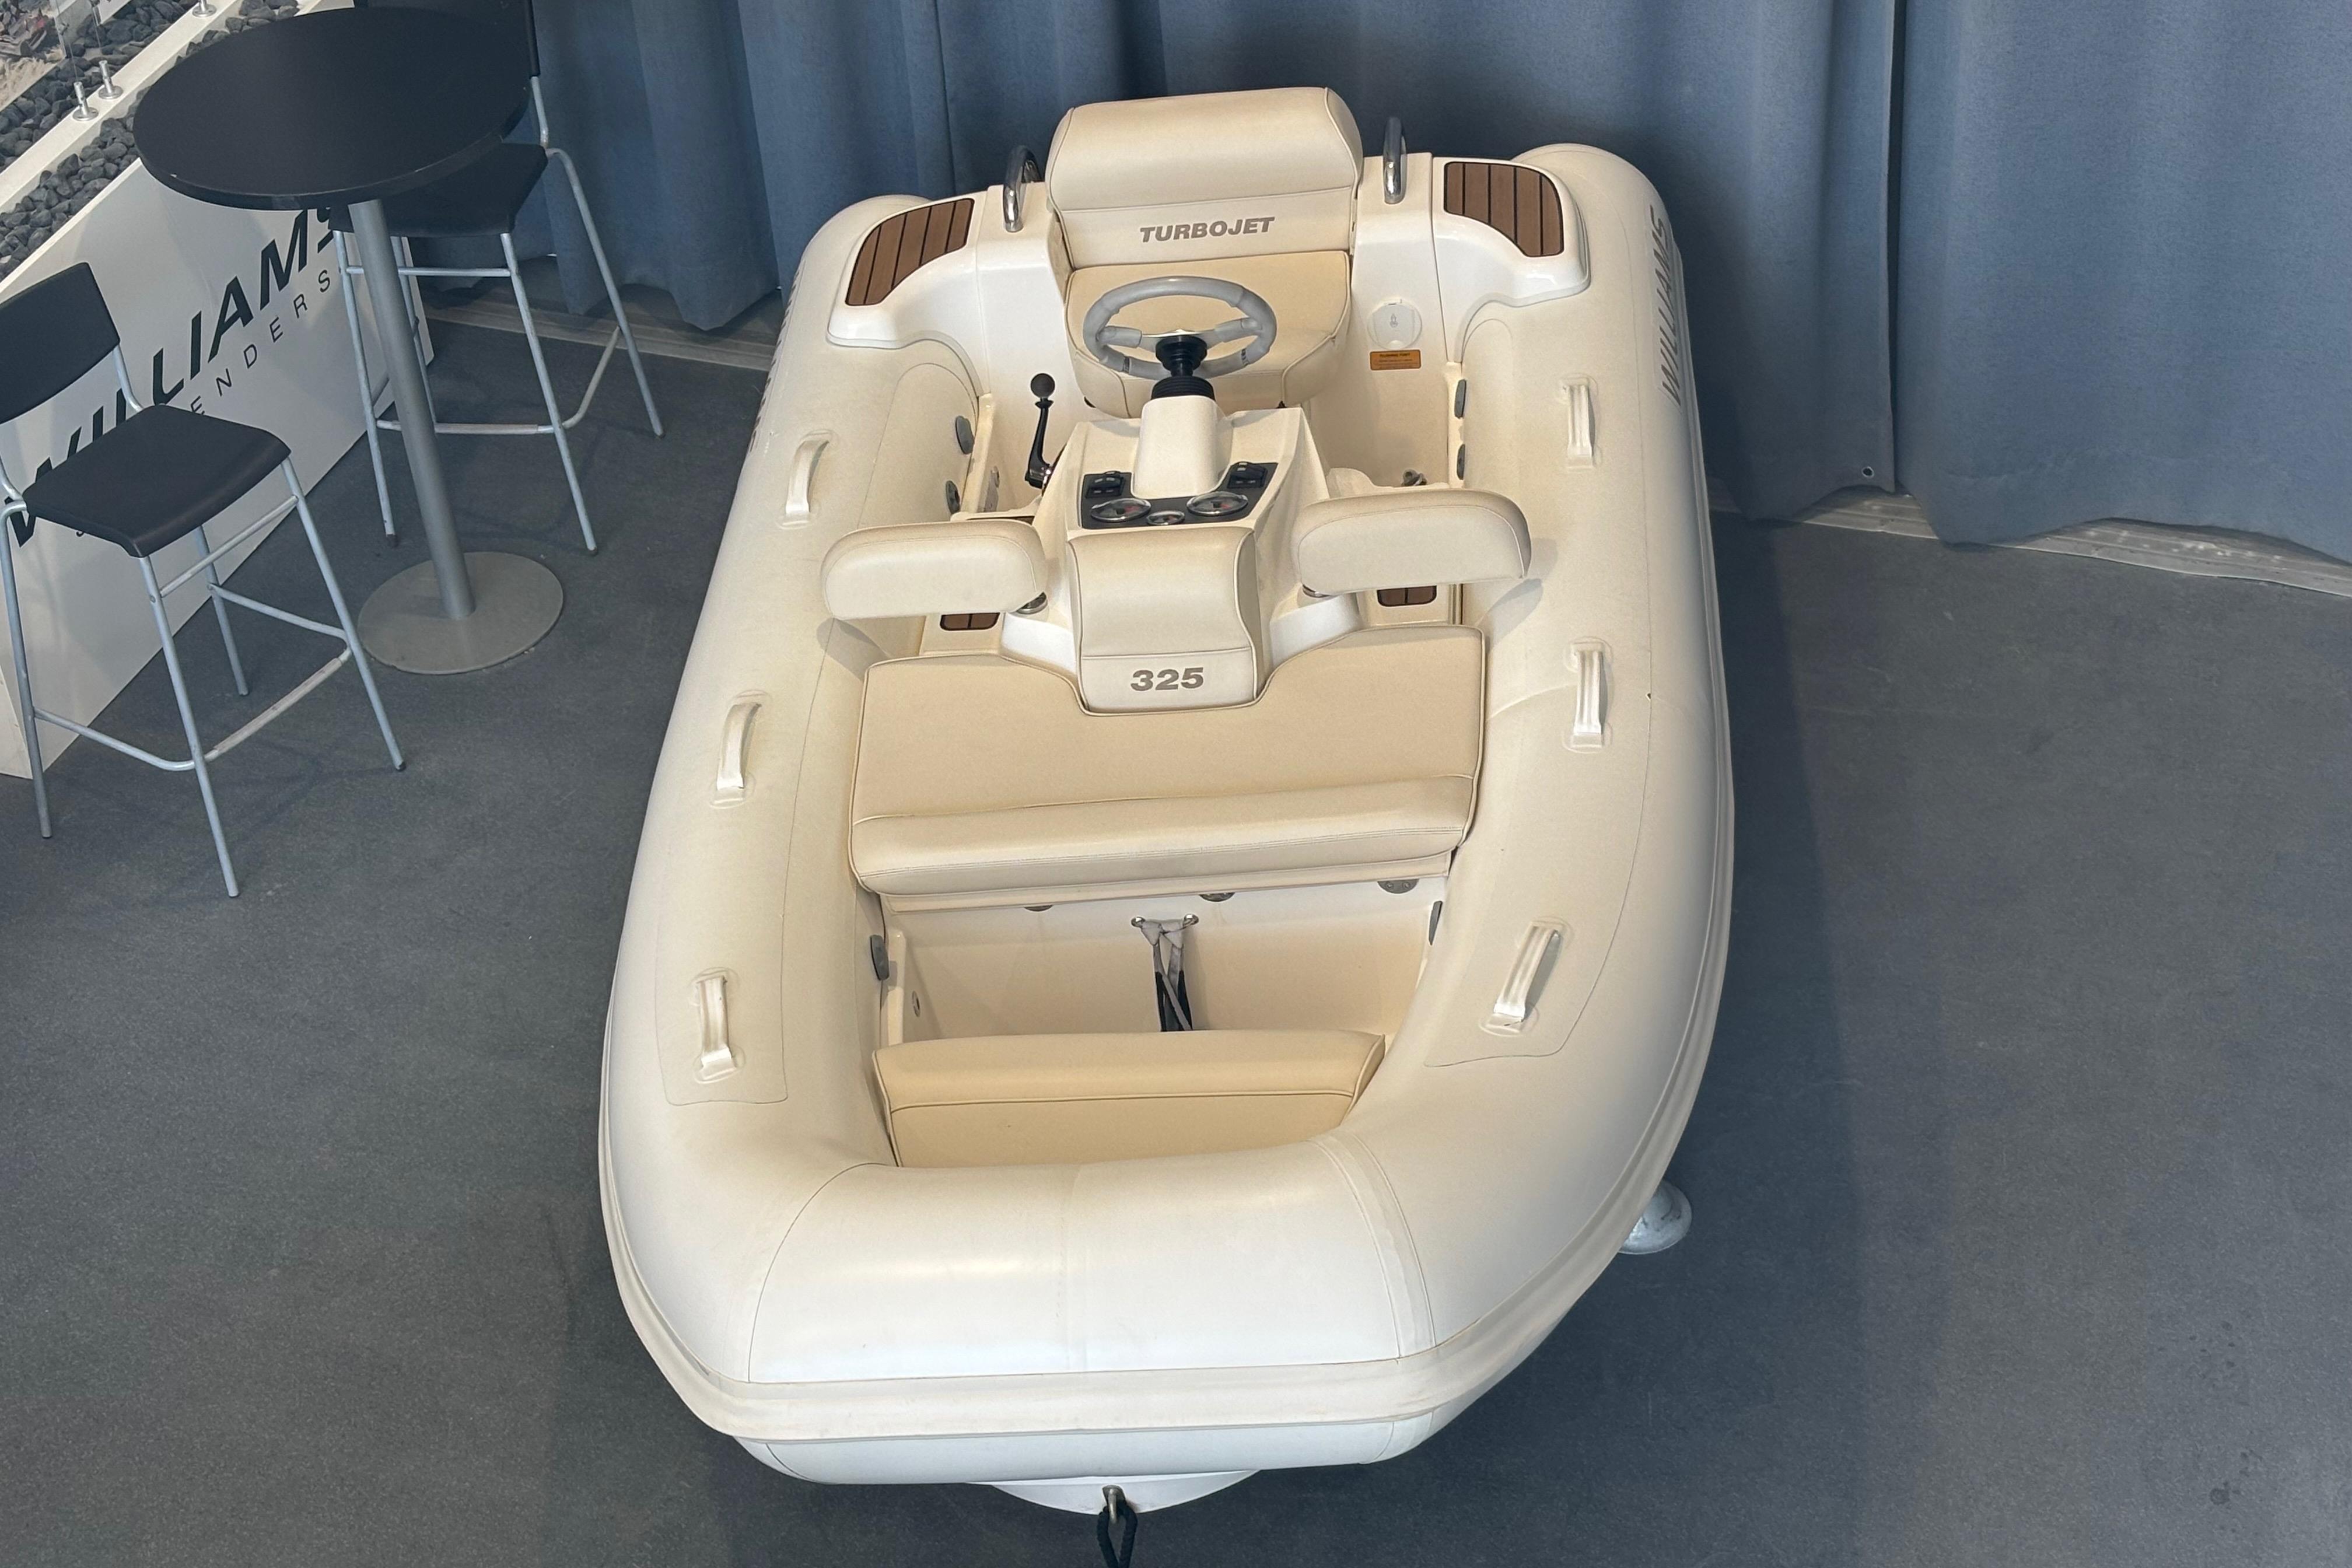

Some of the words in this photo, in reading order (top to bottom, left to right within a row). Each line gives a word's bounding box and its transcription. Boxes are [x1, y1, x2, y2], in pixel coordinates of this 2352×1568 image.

[1140, 216, 1275, 243] TURBOJET
[190, 269, 331, 415] ENDERS
[1130, 667, 1203, 691] 325
